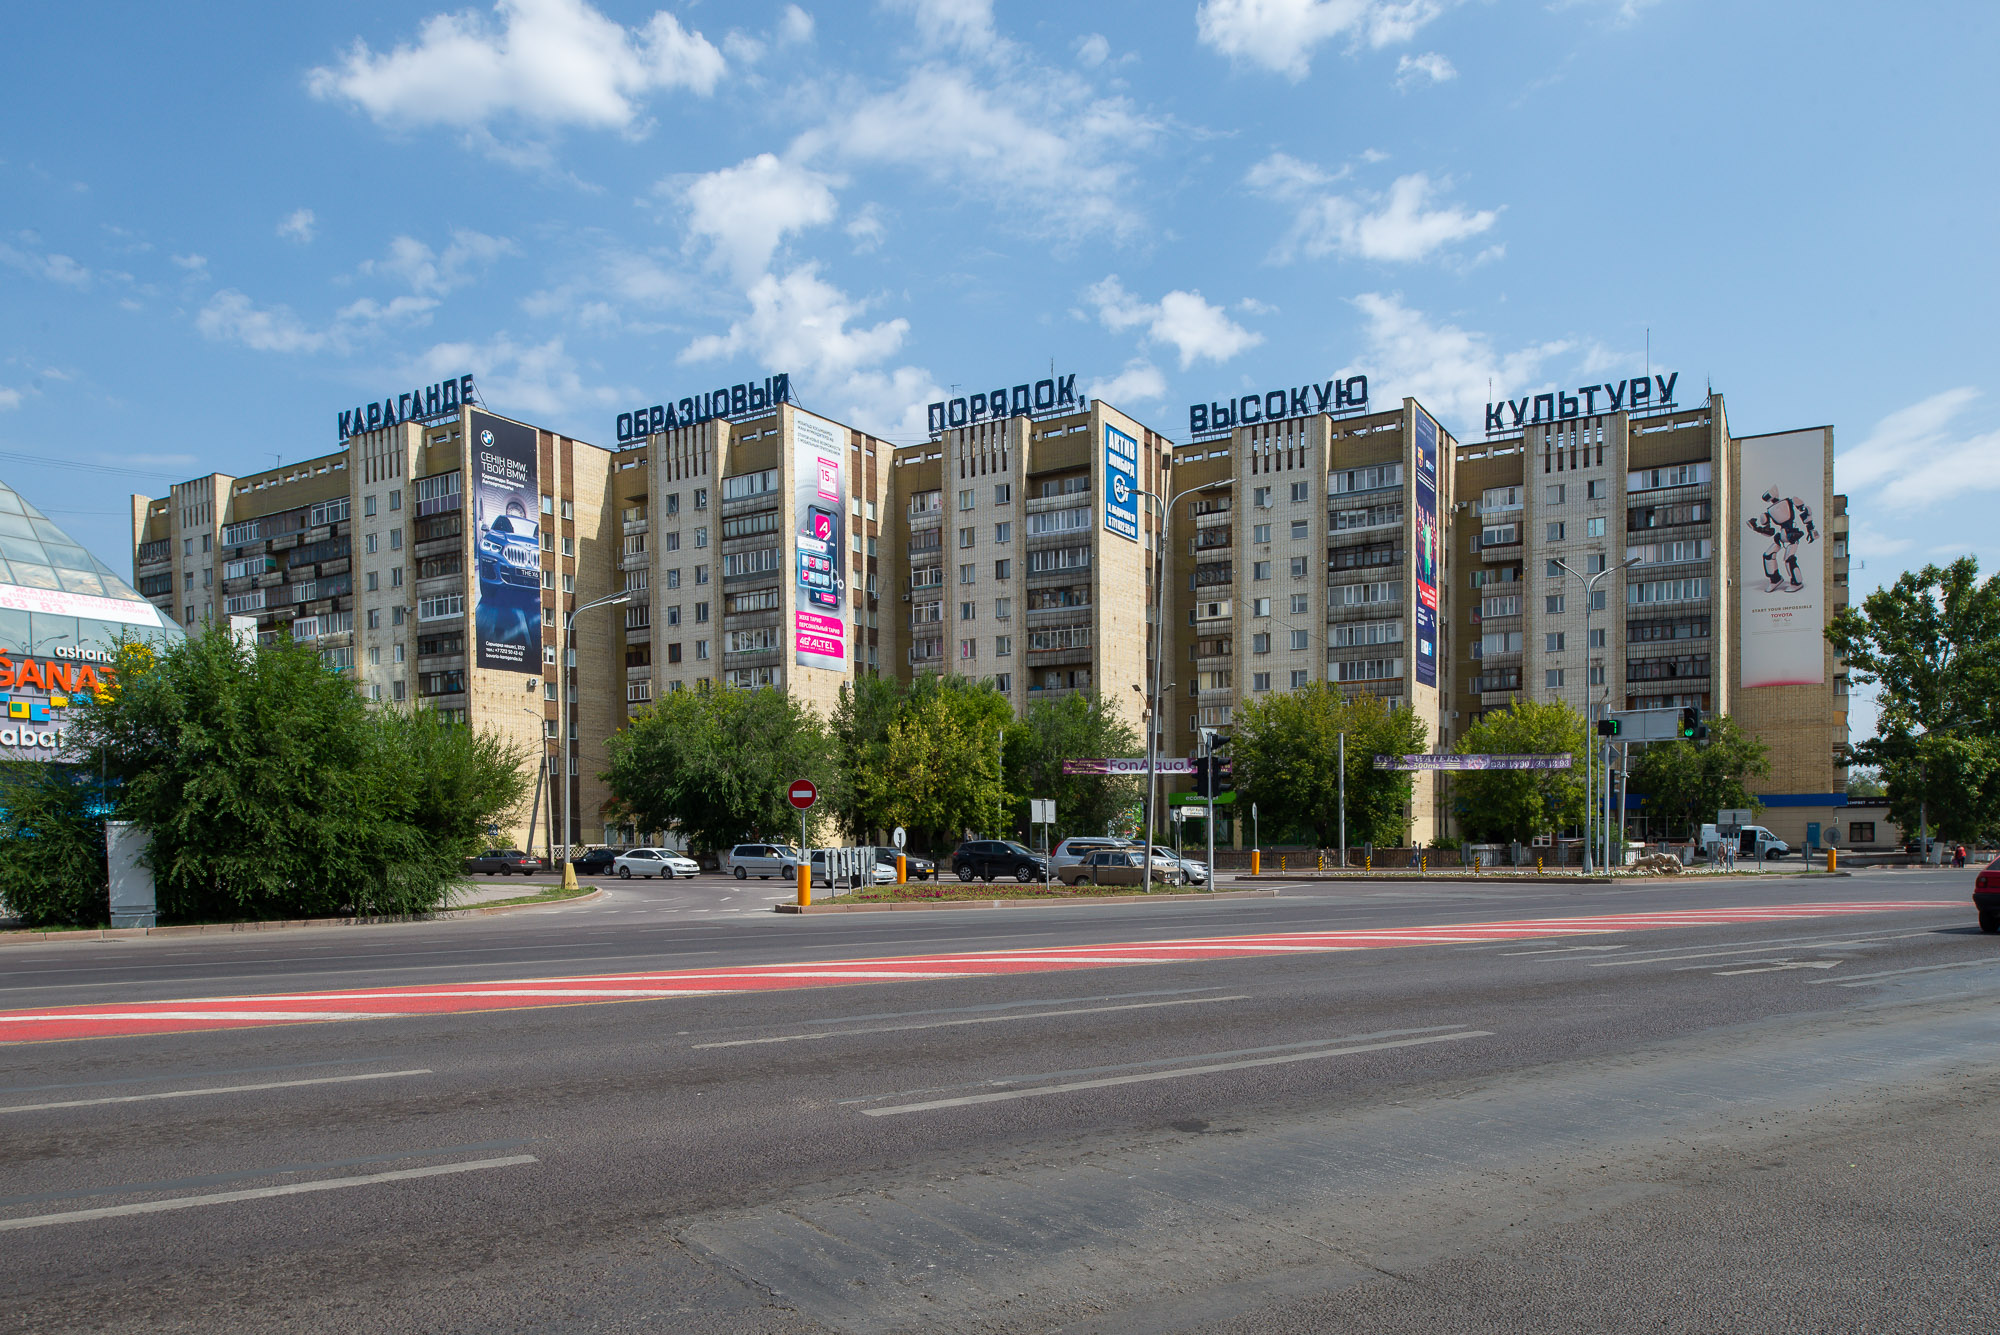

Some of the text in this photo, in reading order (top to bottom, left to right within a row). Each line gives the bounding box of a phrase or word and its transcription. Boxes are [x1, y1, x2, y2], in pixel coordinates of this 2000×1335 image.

[338, 373, 474, 440] КАРАГАНДЕ
[616, 373, 789, 441] ОБРАЗЦОВЫЙ
[928, 373, 1085, 432] ПОРЯДОК,
[1190, 375, 1368, 432] ВЫСОКУЮ
[1485, 372, 1679, 431] КУЛЬТУРУ
[1108, 430, 1135, 461] АКТИВ
[481, 461, 528, 482] ТВОЙ BMW.
[506, 458, 528, 473] BMW.
[821, 469, 829, 482] 15
[811, 639, 835, 650] ALTEL
[1609, 720, 1617, 734] 7
[1415, 755, 1461, 763] WATERS
